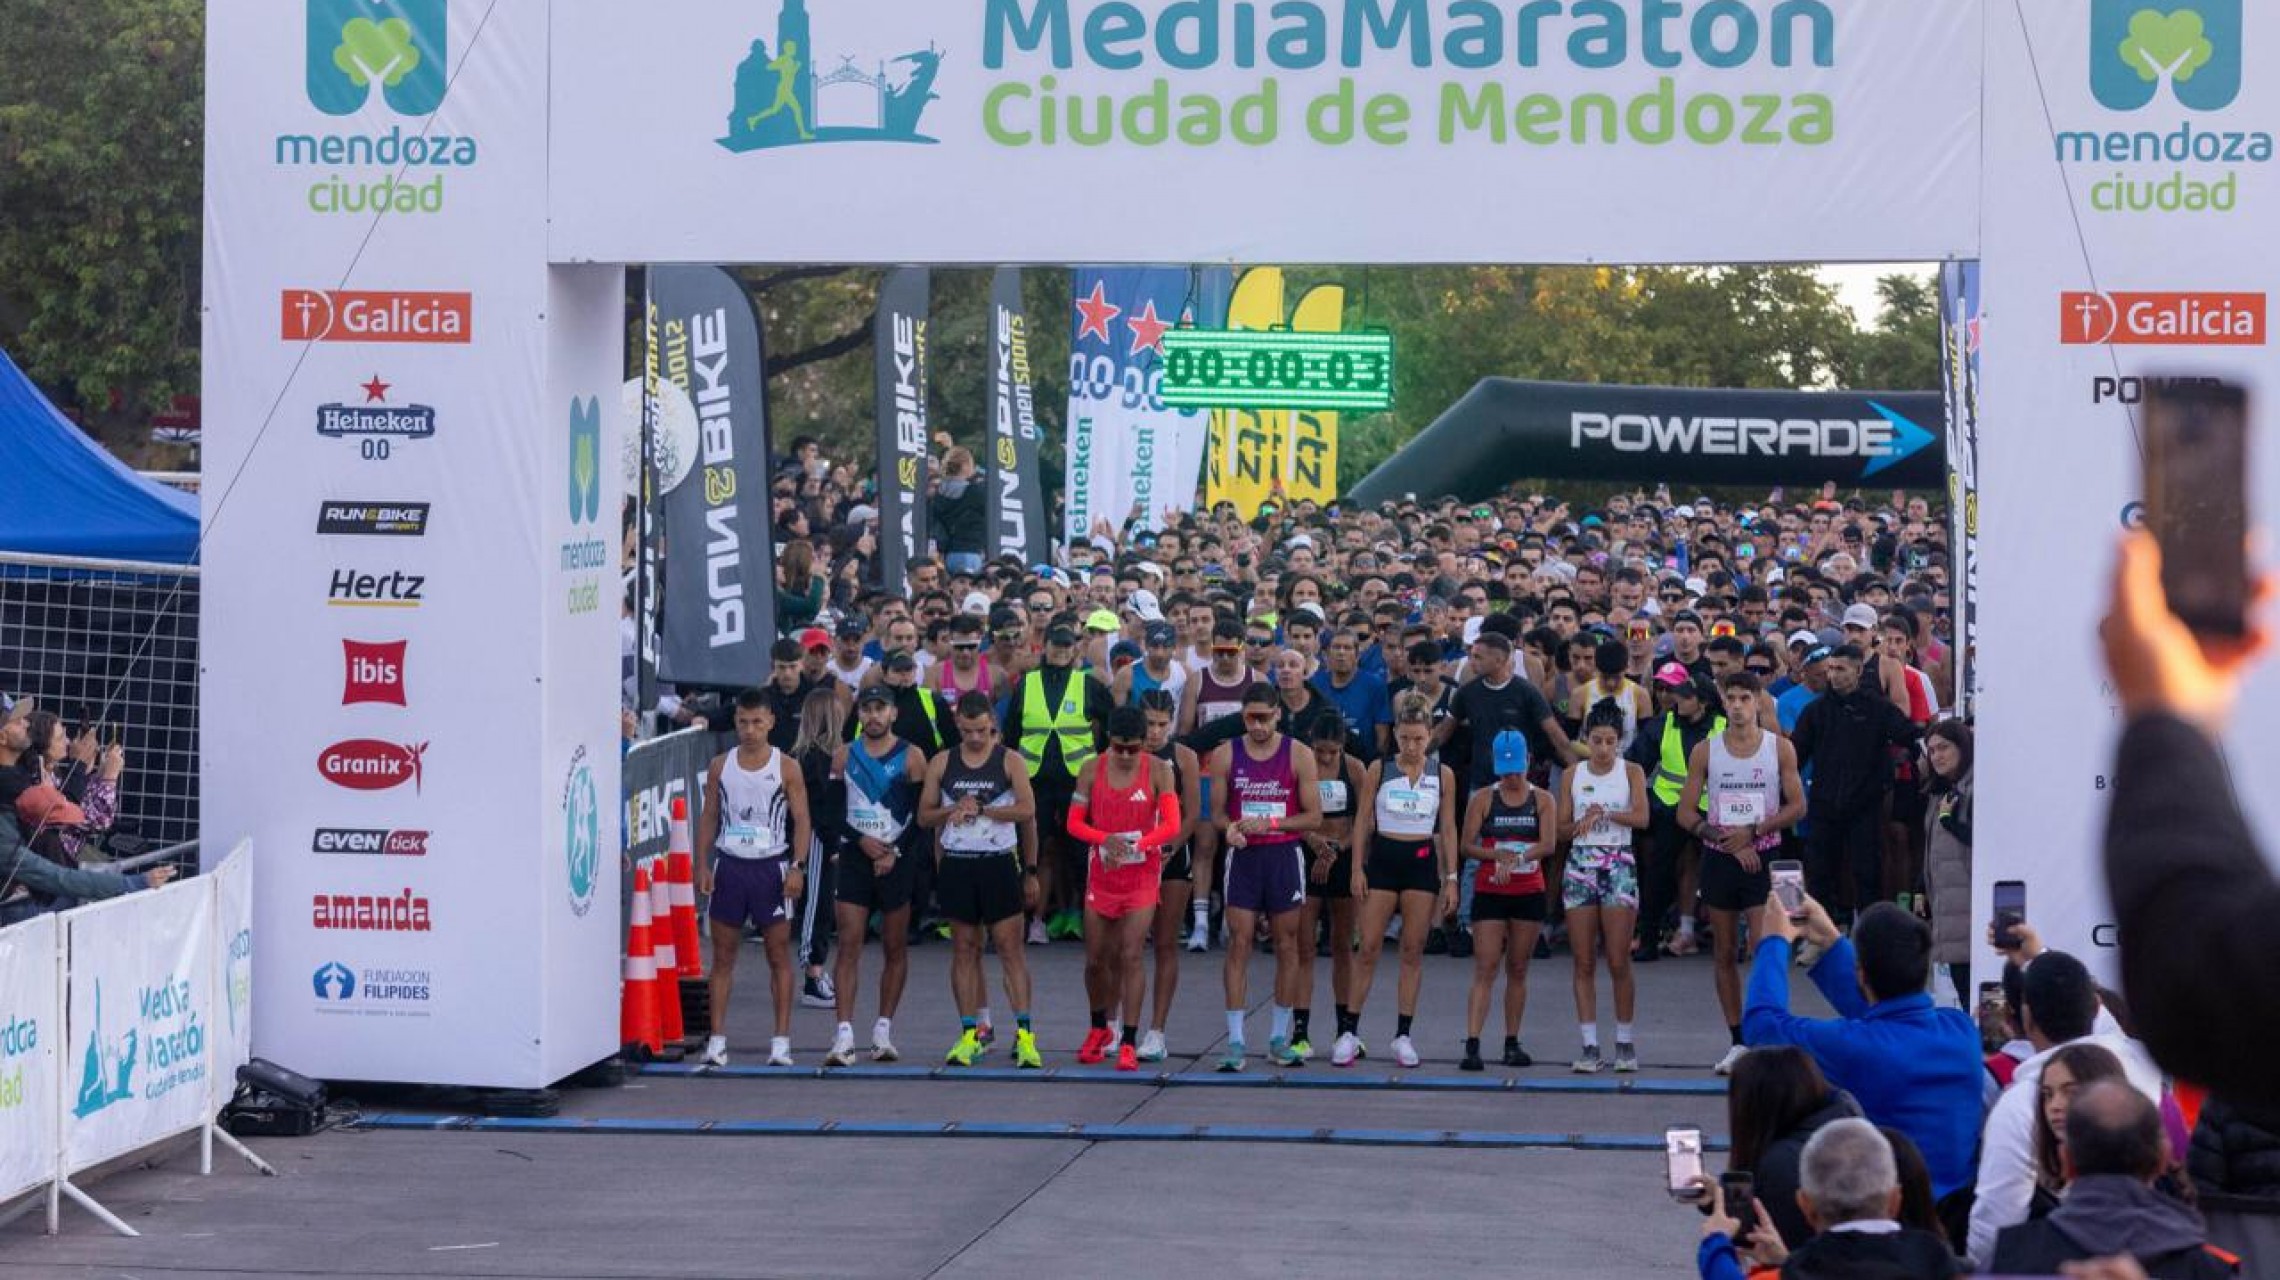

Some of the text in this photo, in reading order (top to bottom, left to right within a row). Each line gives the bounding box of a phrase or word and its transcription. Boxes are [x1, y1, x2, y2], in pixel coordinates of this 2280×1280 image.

[982, 75, 1834, 146] Ciudad de Mendoza
[276, 126, 477, 165] mendoza
[2056, 122, 2273, 162] mendoza
[308, 174, 443, 213] ciudad
[2091, 171, 2237, 212] ciudad
[342, 301, 461, 334] Galicia
[2126, 300, 2254, 336] Galicia
[1167, 349, 1385, 389] 00:00:03
[323, 409, 428, 432] Heineken
[1571, 412, 1894, 457] POWERADE
[361, 438, 390, 461] 0.0
[1067, 417, 1093, 536] eineken
[328, 568, 426, 600] Hertz
[352, 656, 398, 684] ibis
[325, 753, 402, 775] Granix
[312, 887, 431, 931] amanda
[363, 984, 430, 1001] FILIPIDES
